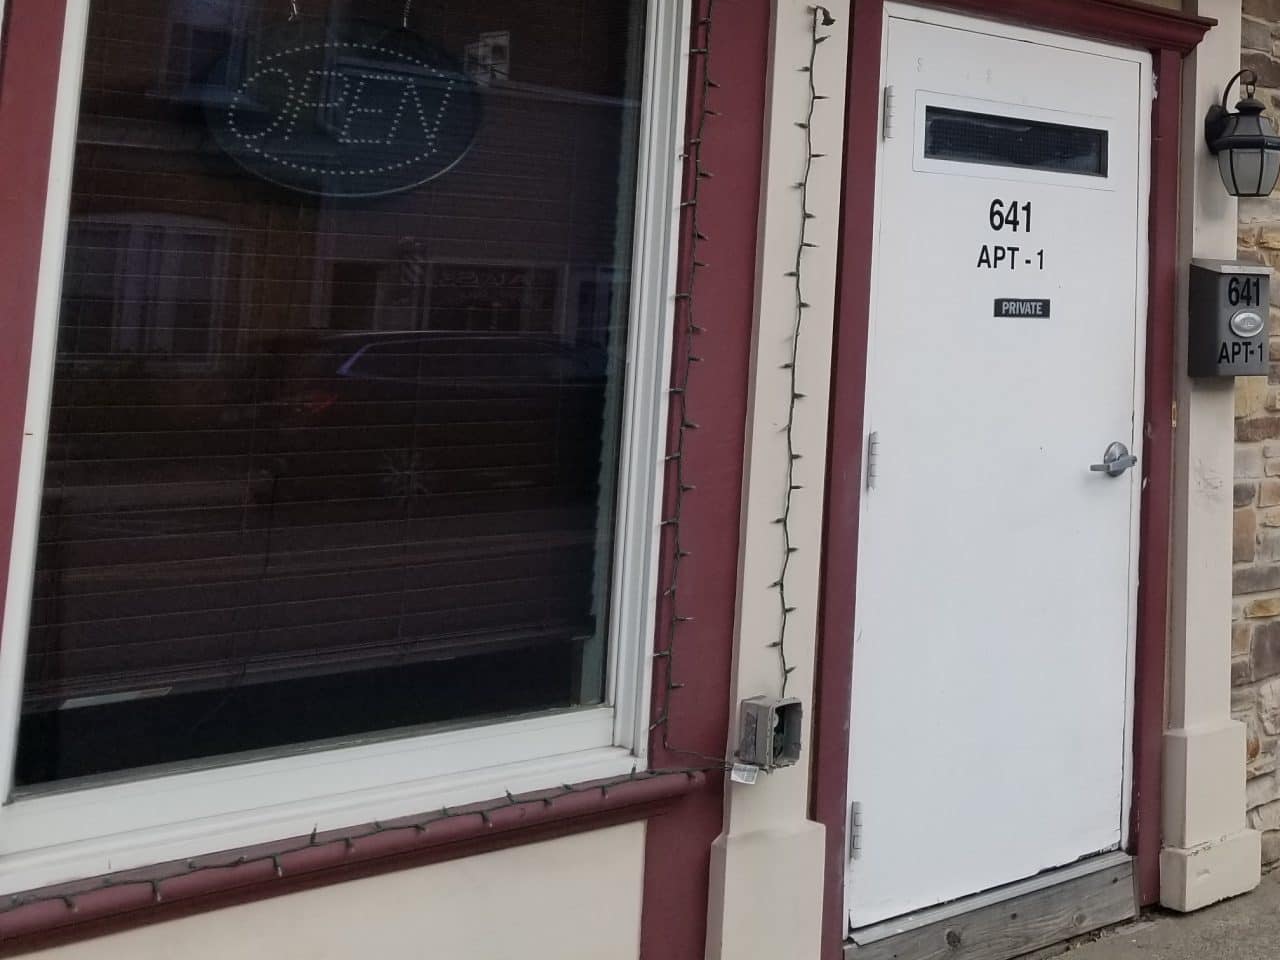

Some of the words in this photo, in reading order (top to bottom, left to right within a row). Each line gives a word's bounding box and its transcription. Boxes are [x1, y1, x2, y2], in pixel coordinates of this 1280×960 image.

[229, 67, 455, 153] OPEN
[989, 198, 1032, 233] 641
[1001, 300, 1043, 315] PRIVATE
[1228, 276, 1260, 307] 641
